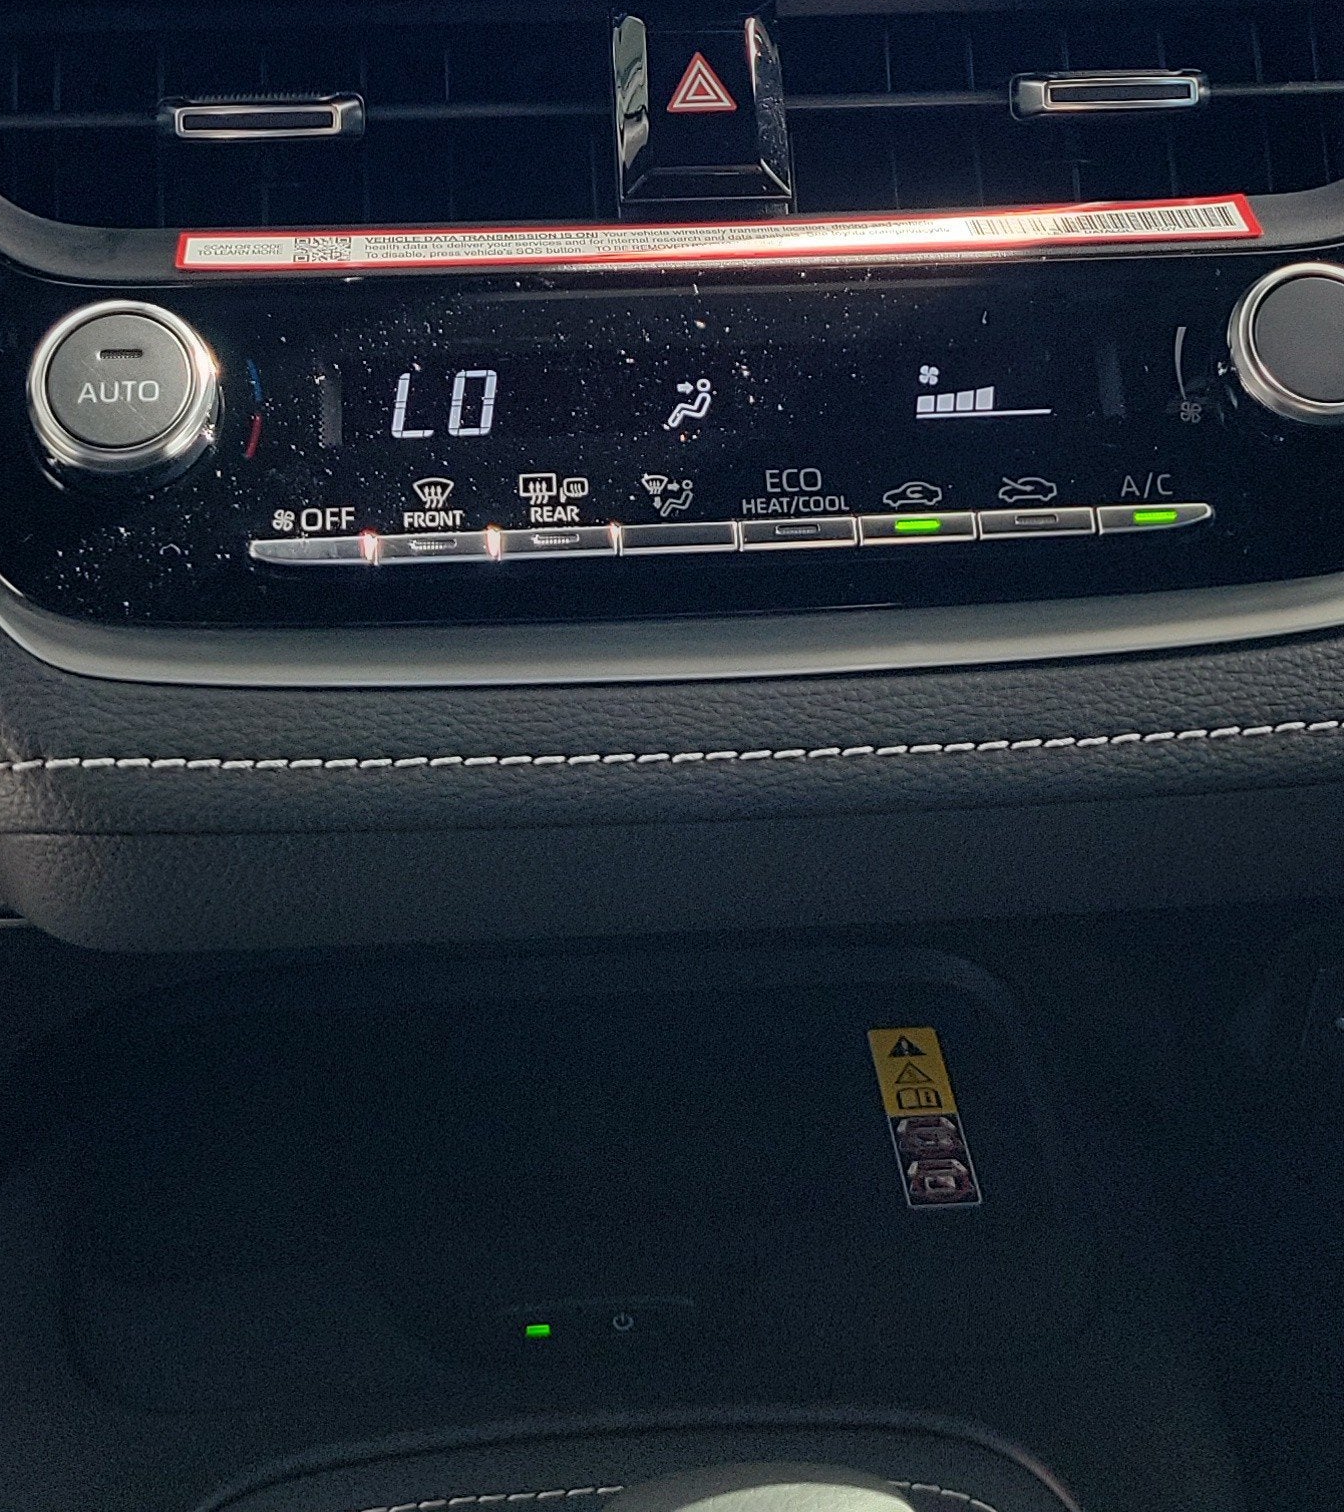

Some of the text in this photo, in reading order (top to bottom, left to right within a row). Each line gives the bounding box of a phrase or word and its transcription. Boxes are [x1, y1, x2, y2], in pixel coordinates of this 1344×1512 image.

[364, 243, 401, 251] health
[447, 241, 484, 249] deliver
[487, 241, 513, 250] your
[515, 239, 562, 247] services
[565, 238, 586, 246] and
[652, 234, 701, 244] research
[704, 233, 725, 242] and
[365, 236, 422, 244] VEHICLE
[459, 233, 557, 242] TRANSMISSION
[630, 229, 671, 237] vehicle
[672, 226, 727, 236] wirelessly
[729, 225, 780, 234] transmits
[429, 249, 461, 258] press
[516, 246, 542, 255] SOS
[77, 380, 160, 404] AUTO
[391, 369, 498, 439] LO
[764, 467, 824, 493] ECO
[1120, 471, 1175, 499] A/C
[529, 504, 581, 524] REAR
[741, 494, 851, 516] HEAT/COOL
[299, 507, 356, 533] OFF
[402, 510, 465, 529] FRONT
